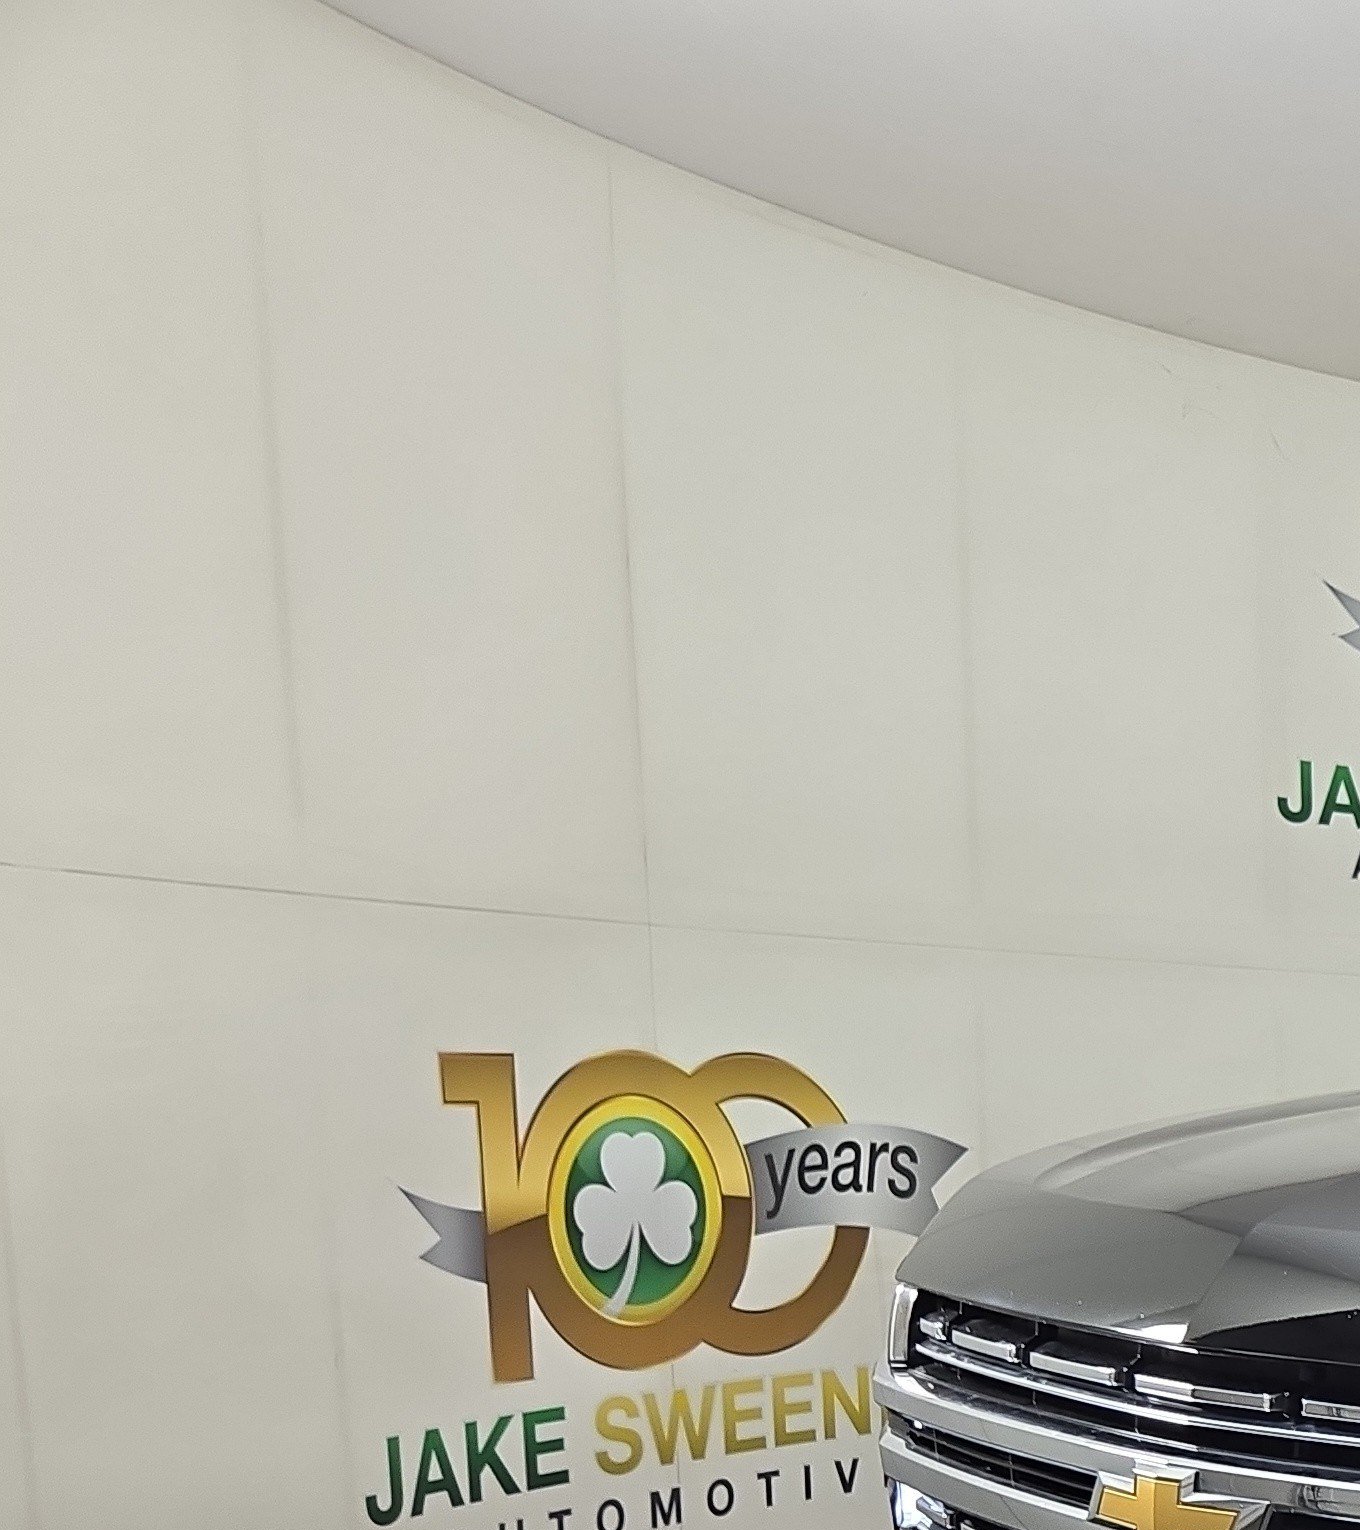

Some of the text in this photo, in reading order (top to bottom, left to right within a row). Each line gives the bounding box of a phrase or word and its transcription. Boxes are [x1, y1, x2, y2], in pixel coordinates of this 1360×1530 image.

[438, 1049, 870, 1384] 100
[764, 1140, 918, 1218] years
[365, 1365, 889, 1527] JAKE SWEEN
